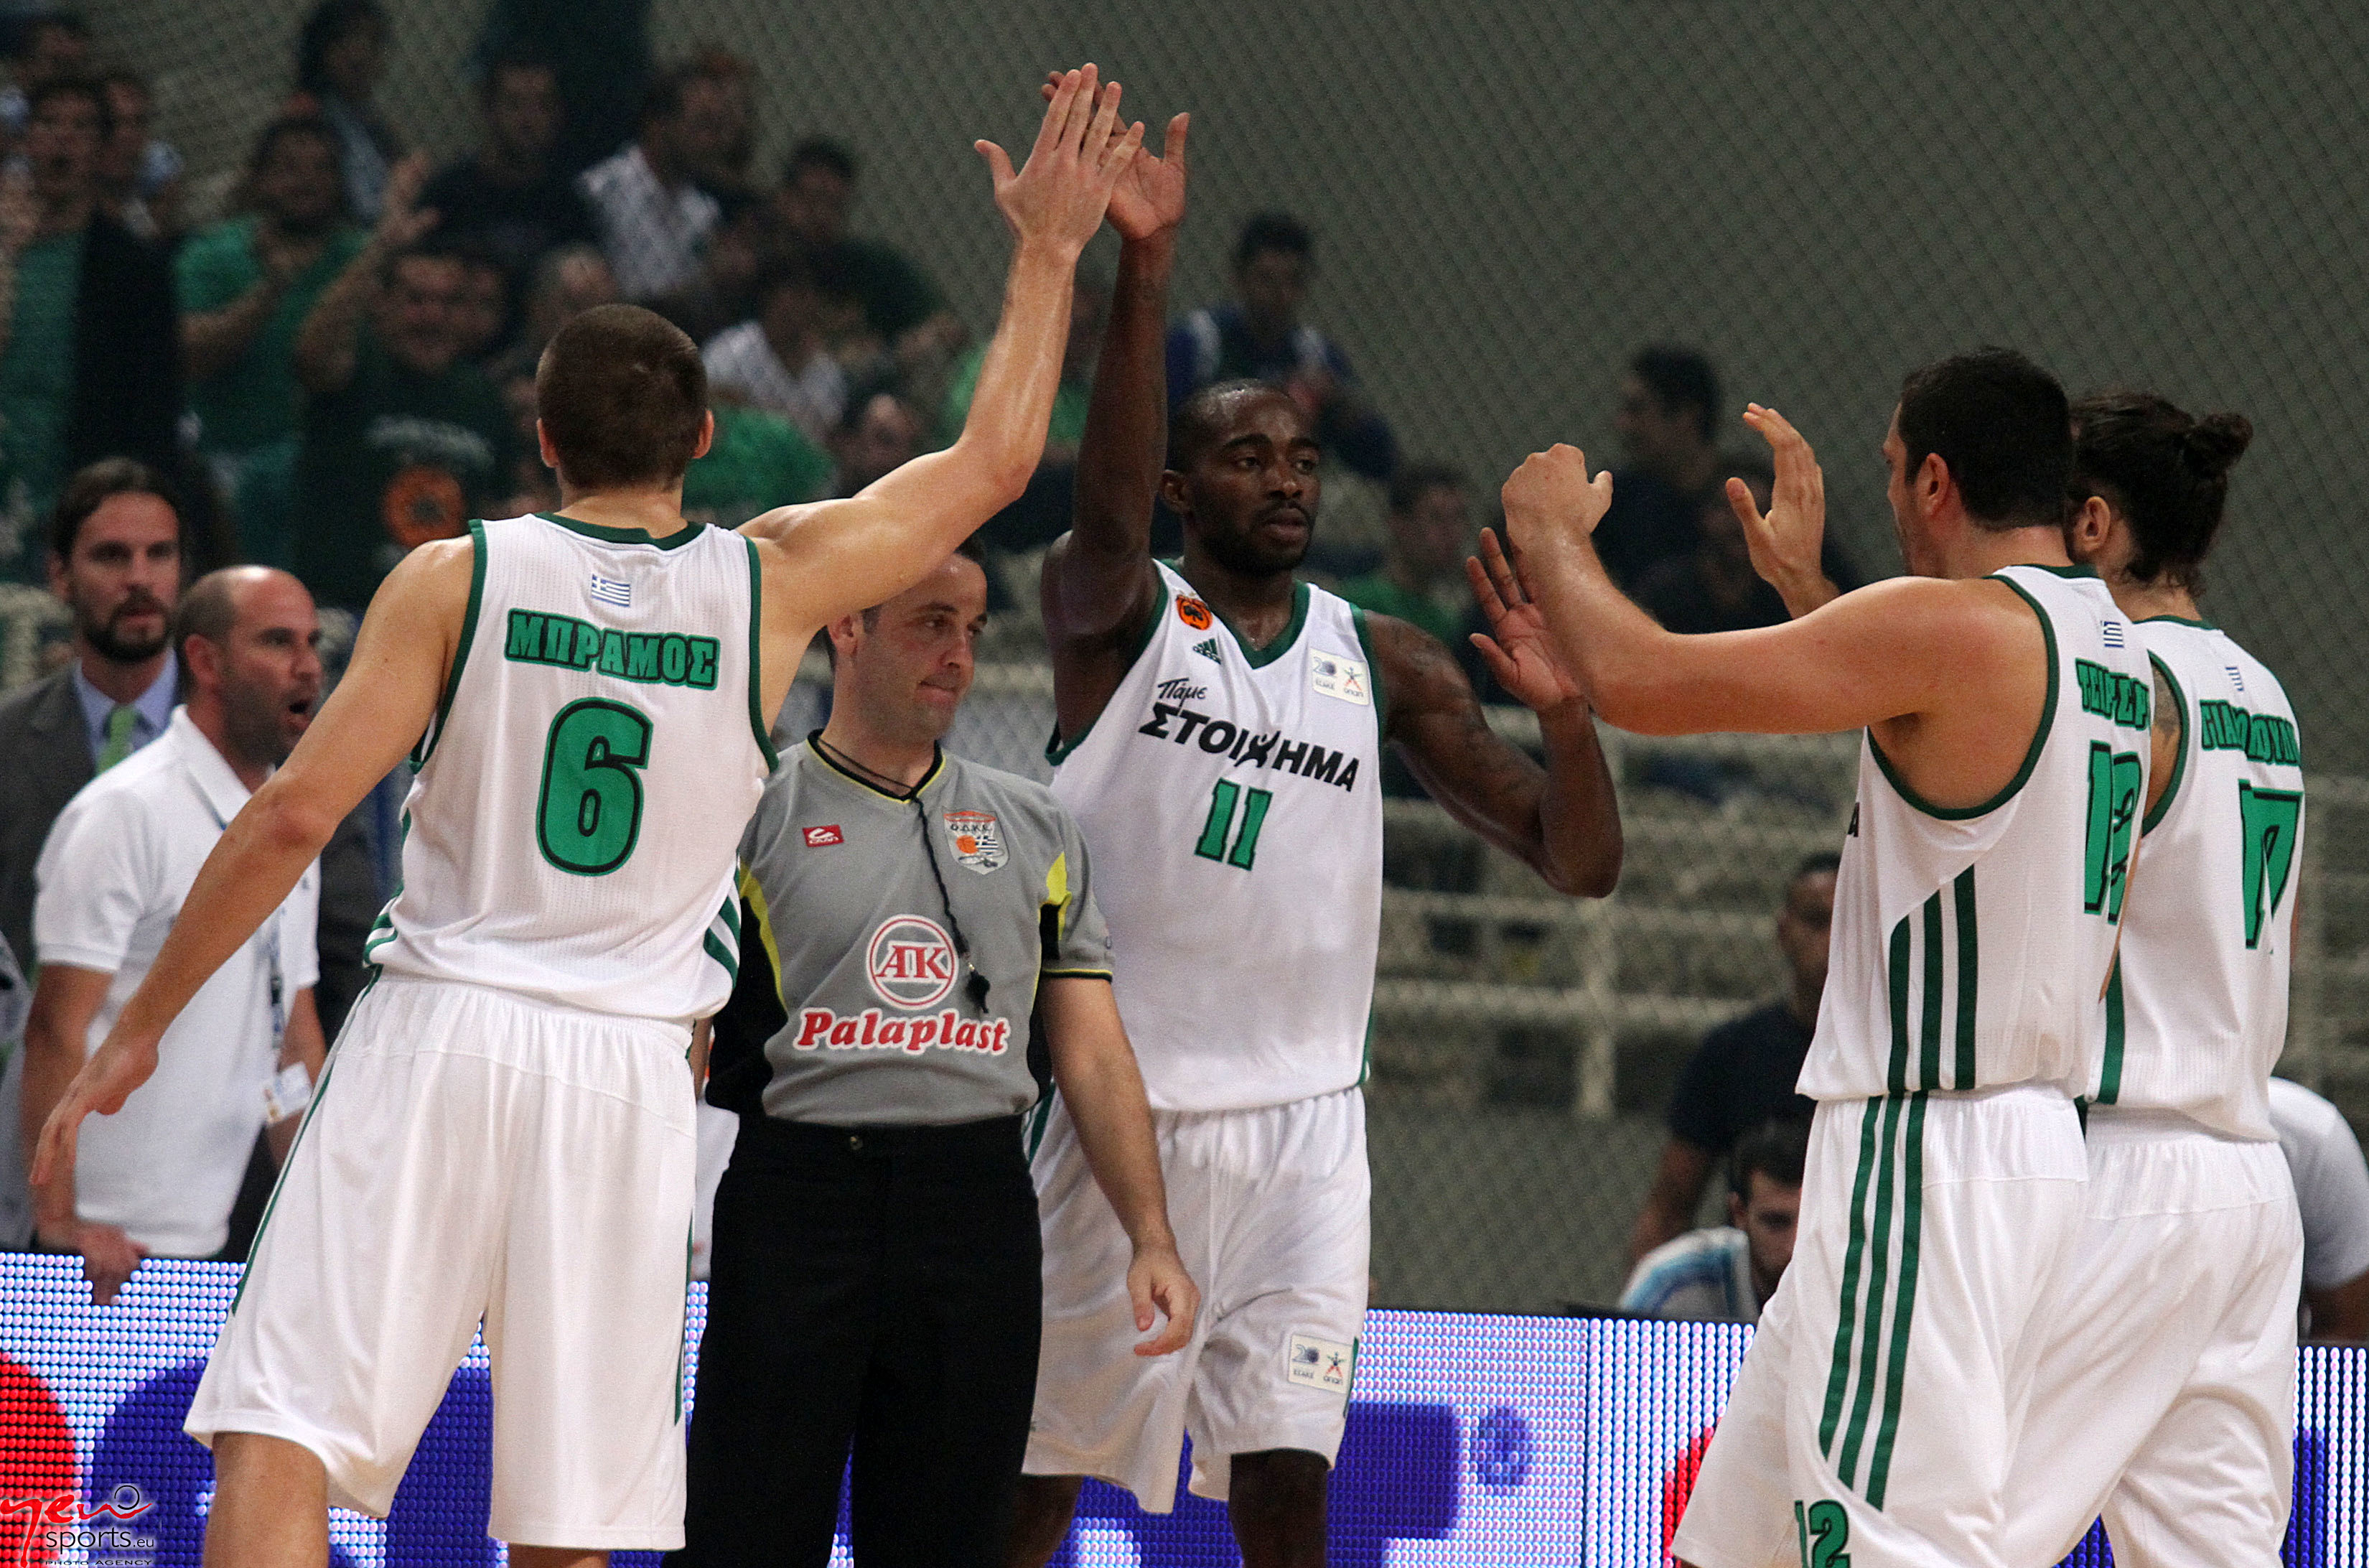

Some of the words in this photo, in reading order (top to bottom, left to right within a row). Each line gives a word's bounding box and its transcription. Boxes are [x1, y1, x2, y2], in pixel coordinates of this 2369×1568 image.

[505, 608, 720, 690] ΜΠΡΑΜΟΣ
[536, 697, 653, 876] 6
[1194, 778, 1273, 871] 11
[794, 1007, 1009, 1053] Palaplast
